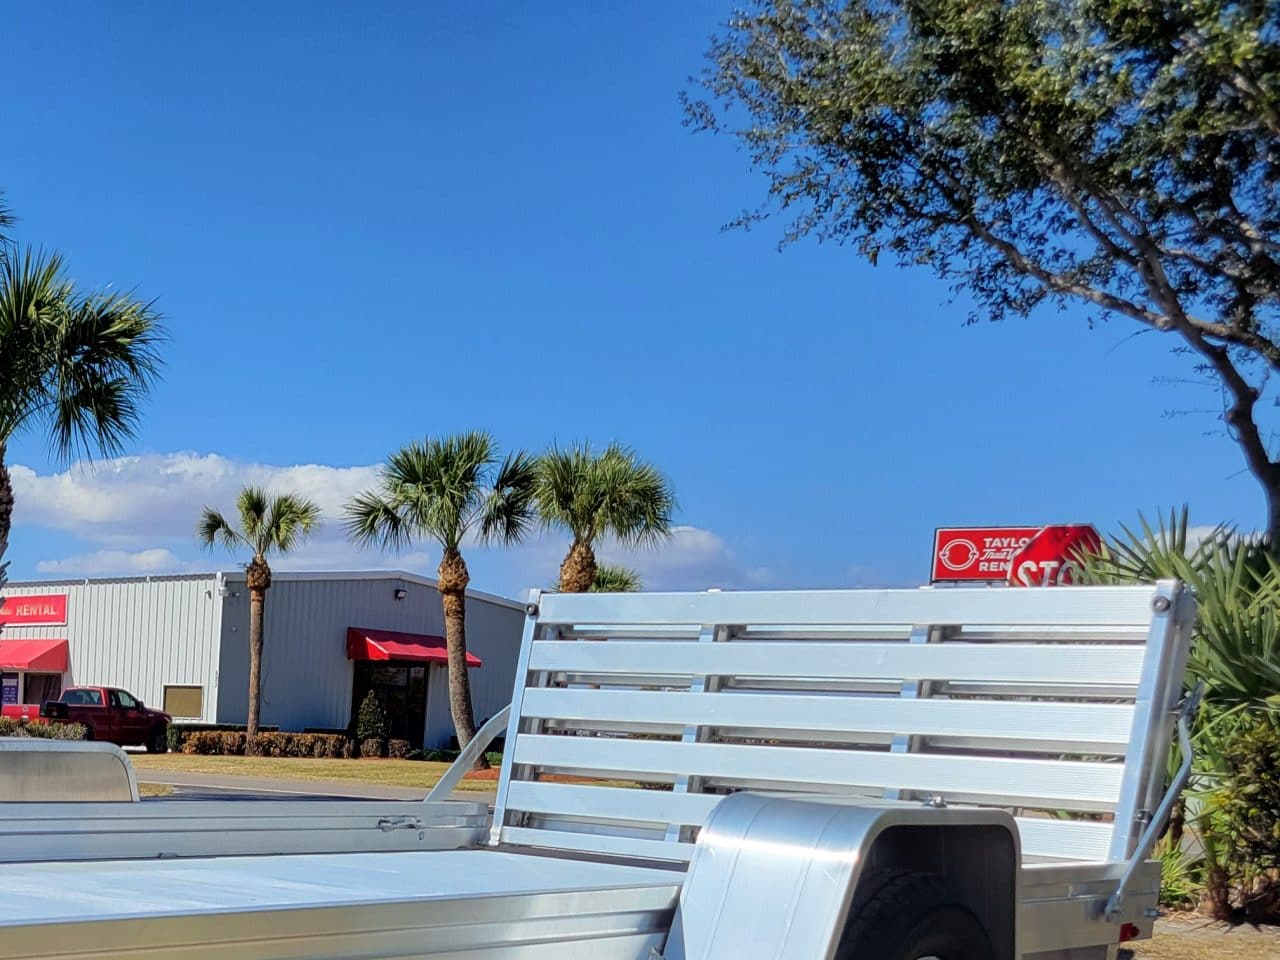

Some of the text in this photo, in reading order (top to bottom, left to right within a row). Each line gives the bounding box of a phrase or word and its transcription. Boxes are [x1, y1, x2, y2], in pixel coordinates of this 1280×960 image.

[983, 537, 1030, 548] TAYLO
[978, 561, 1009, 572] REN
[1017, 560, 1080, 586] STO
[15, 604, 57, 616] RENTAL
